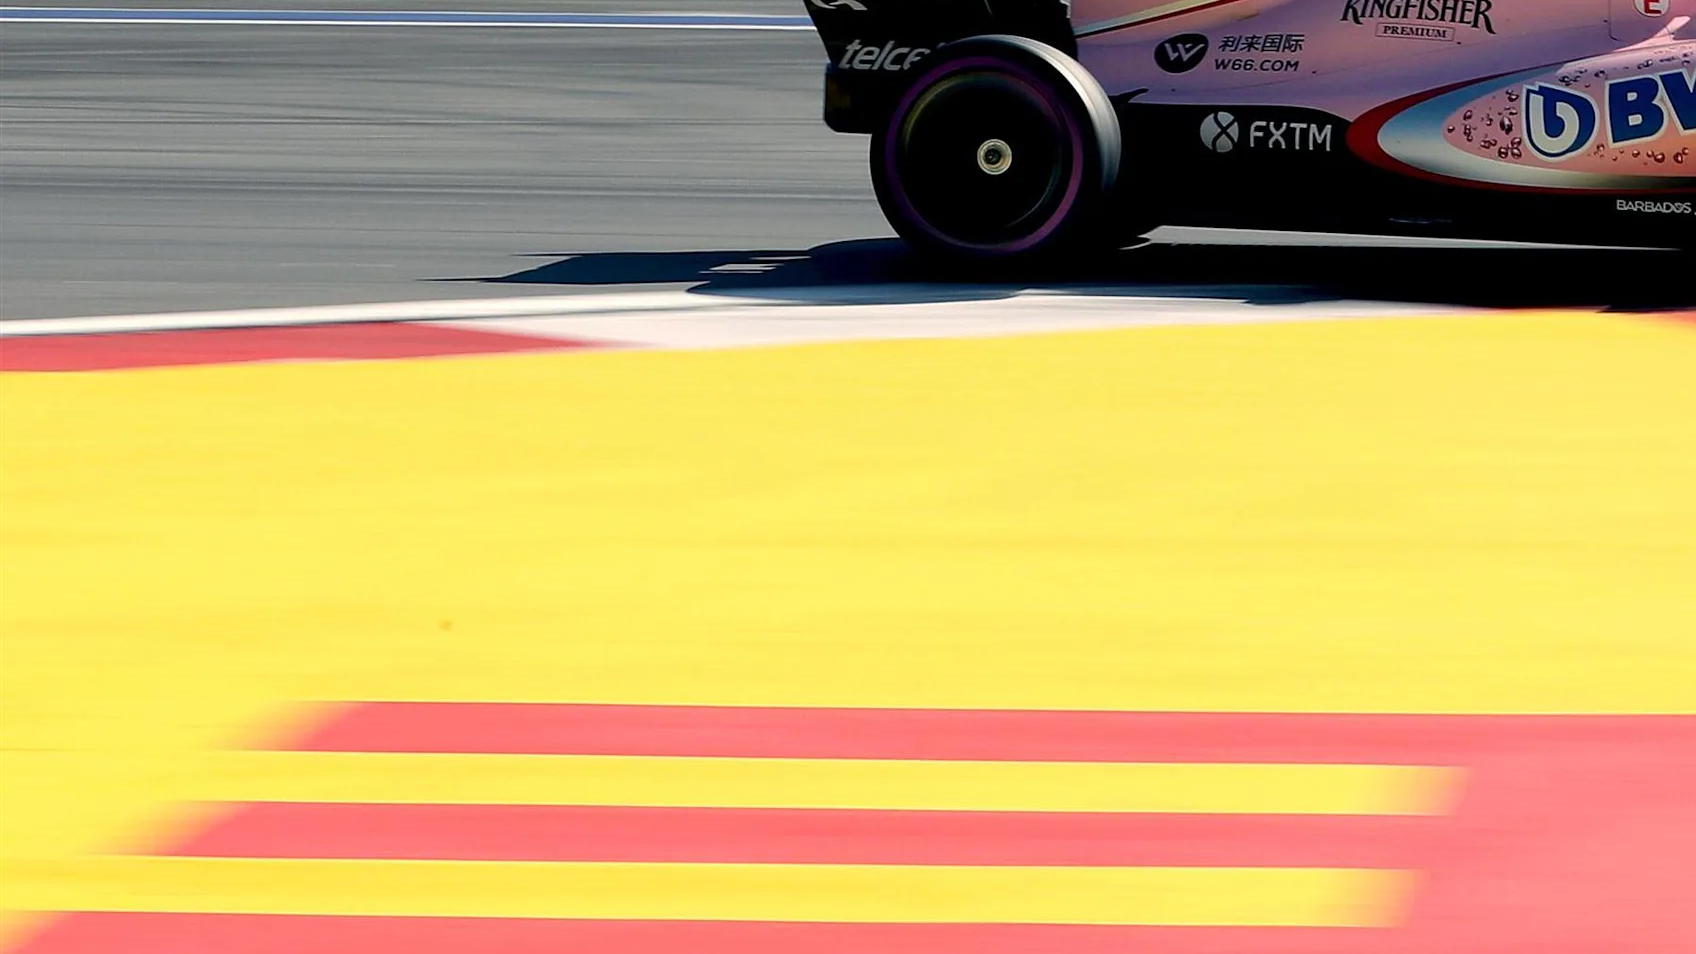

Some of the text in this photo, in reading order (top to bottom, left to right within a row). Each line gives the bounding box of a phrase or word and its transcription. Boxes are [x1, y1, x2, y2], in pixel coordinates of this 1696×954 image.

[1383, 25, 1448, 39] PREMIUM
[1218, 34, 1306, 54] 利来国际
[838, 39, 946, 71] telce
[1214, 58, 1300, 72] W66.COM
[1250, 121, 1332, 152] FXTM
[1616, 199, 1692, 214] BARBADOS
